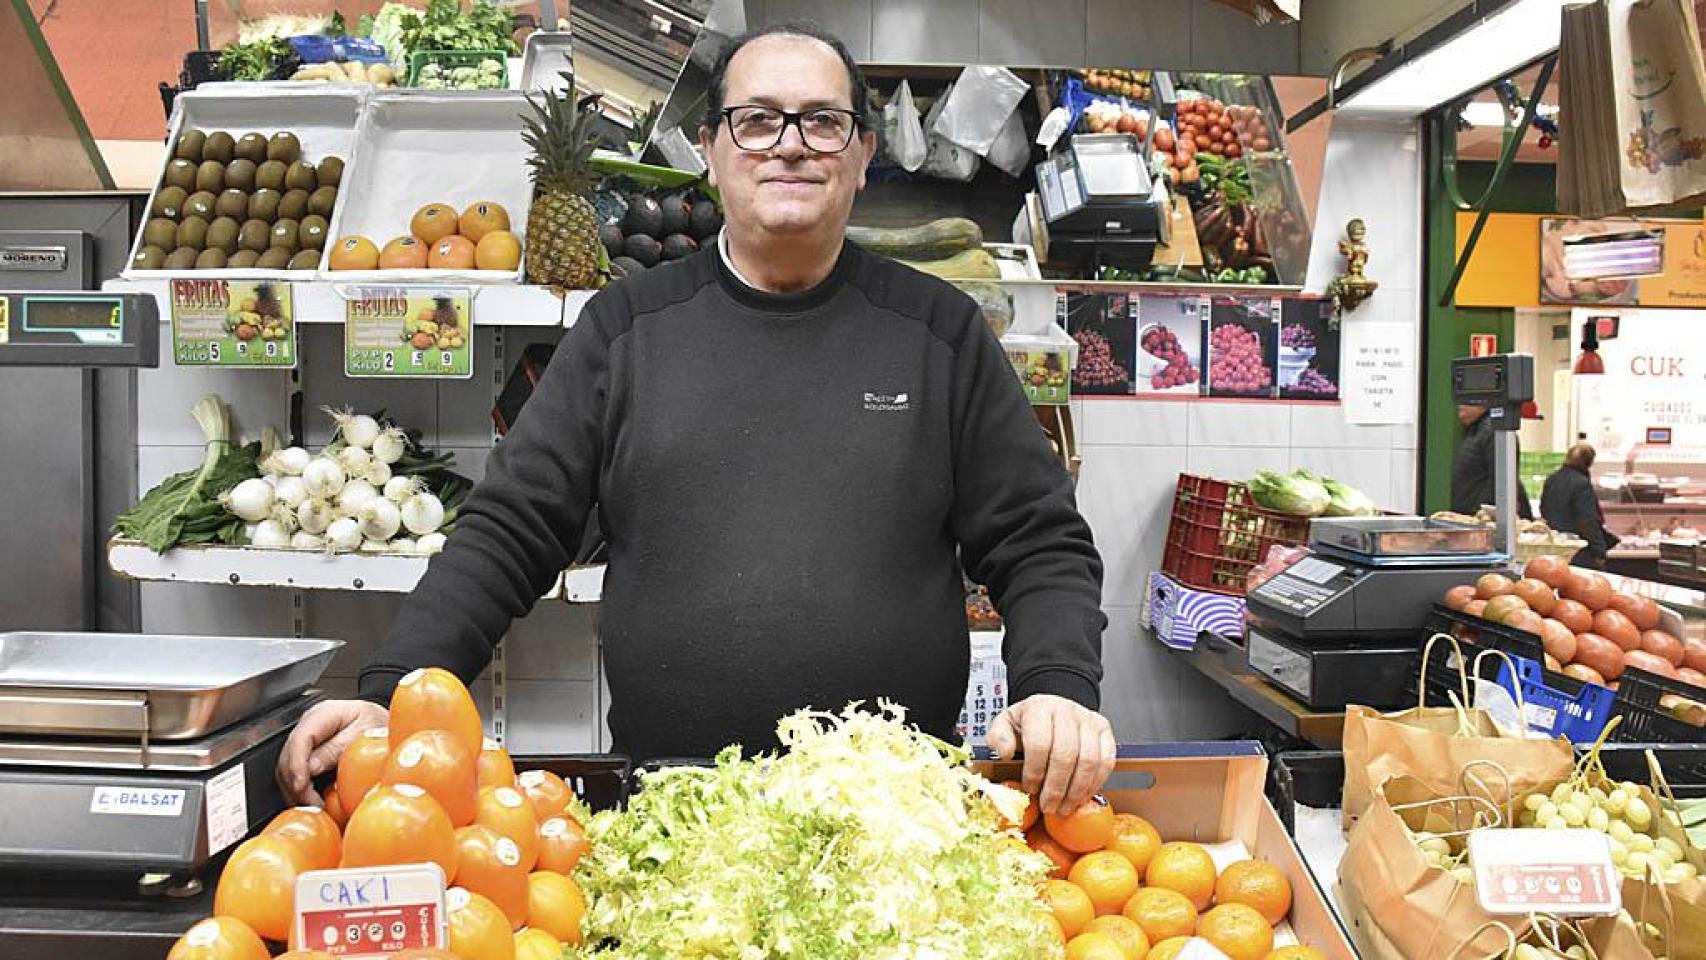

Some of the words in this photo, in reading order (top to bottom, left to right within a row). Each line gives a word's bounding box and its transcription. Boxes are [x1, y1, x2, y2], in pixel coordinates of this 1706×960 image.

[3, 254, 56, 262] MORENO
[174, 280, 230, 308] FRUTAS
[350, 287, 408, 317] FRUTAS
[211, 344, 219, 359] 5
[385, 353, 393, 367] 2
[1631, 356, 1684, 376] CUK
[976, 685, 984, 696] 5
[994, 685, 1002, 696] 6
[974, 698, 986, 710] 12
[993, 697, 1004, 709] 13
[974, 711, 986, 722] 19
[973, 726, 986, 736] 26
[319, 876, 389, 905] CAKI
[382, 942, 404, 950] KILO
